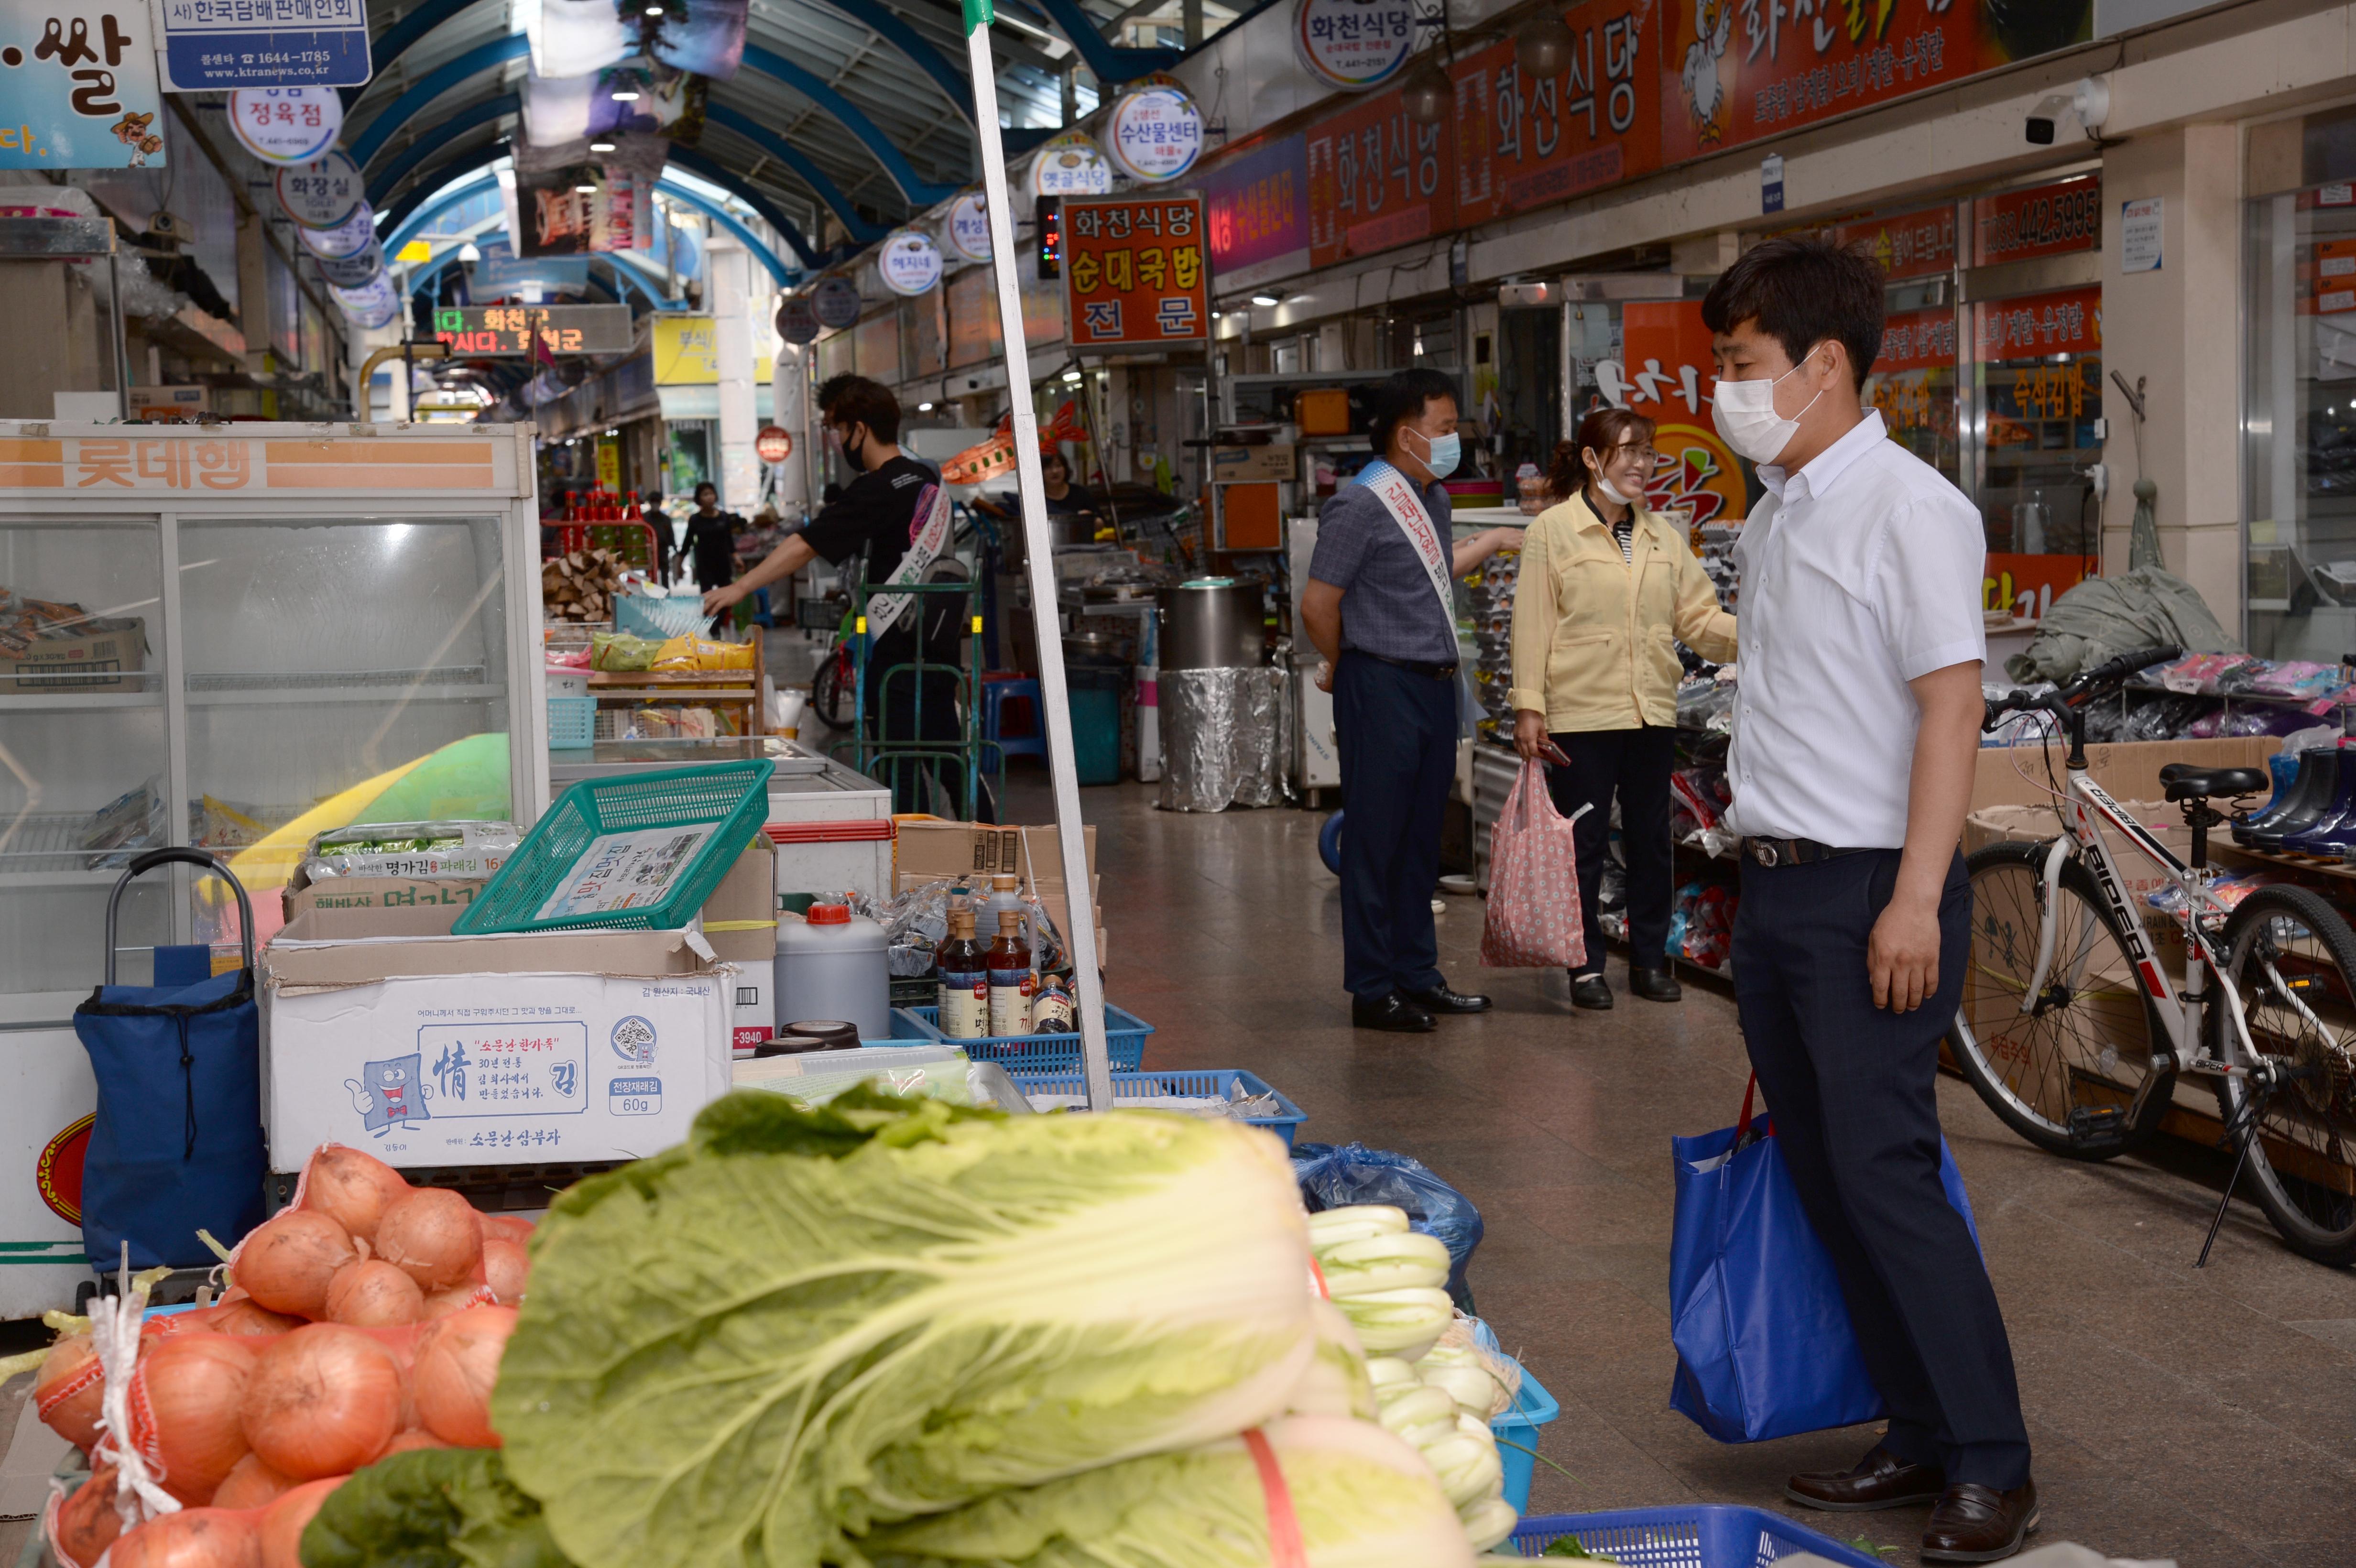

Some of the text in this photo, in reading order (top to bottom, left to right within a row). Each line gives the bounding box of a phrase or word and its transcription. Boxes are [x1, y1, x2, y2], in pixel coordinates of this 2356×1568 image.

[1311, 11, 1410, 41] 화천식당
[200, 51, 330, 65] 콜센타 1644-1785
[204, 65, 329, 78] www.ktranews.co.kr
[251, 102, 321, 127] 정육점
[1121, 121, 1198, 143] 수산물센터
[1337, 110, 1440, 215] 화천식당
[291, 177, 349, 196] 화장실
[1075, 206, 1194, 238] 화천식당
[1070, 244, 1202, 294] 순대국밥
[2013, 362, 2083, 422] 즉석김밥
[358, 863, 383, 873] 바삭한
[385, 860, 429, 876] 명가김
[440, 859, 477, 873] 파래김
[2086, 844, 2148, 964] BIPER
[642, 987, 650, 997] 김
[653, 987, 678, 997] 원산지
[686, 986, 710, 996] 국내산
[417, 1009, 454, 1017] 어머니께서
[473, 1008, 509, 1016] 구워주시던
[734, 1031, 762, 1044] -3940
[432, 1040, 471, 1101] 情
[478, 1056, 522, 1069] 30년 전통
[2195, 1058, 2225, 1072] BIPER
[478, 1073, 529, 1085] 김 회사에서
[552, 1062, 575, 1095] 김
[613, 1080, 658, 1093] 전장재래김
[480, 1087, 544, 1100] 만들었습니다.
[623, 1098, 648, 1111] 60g
